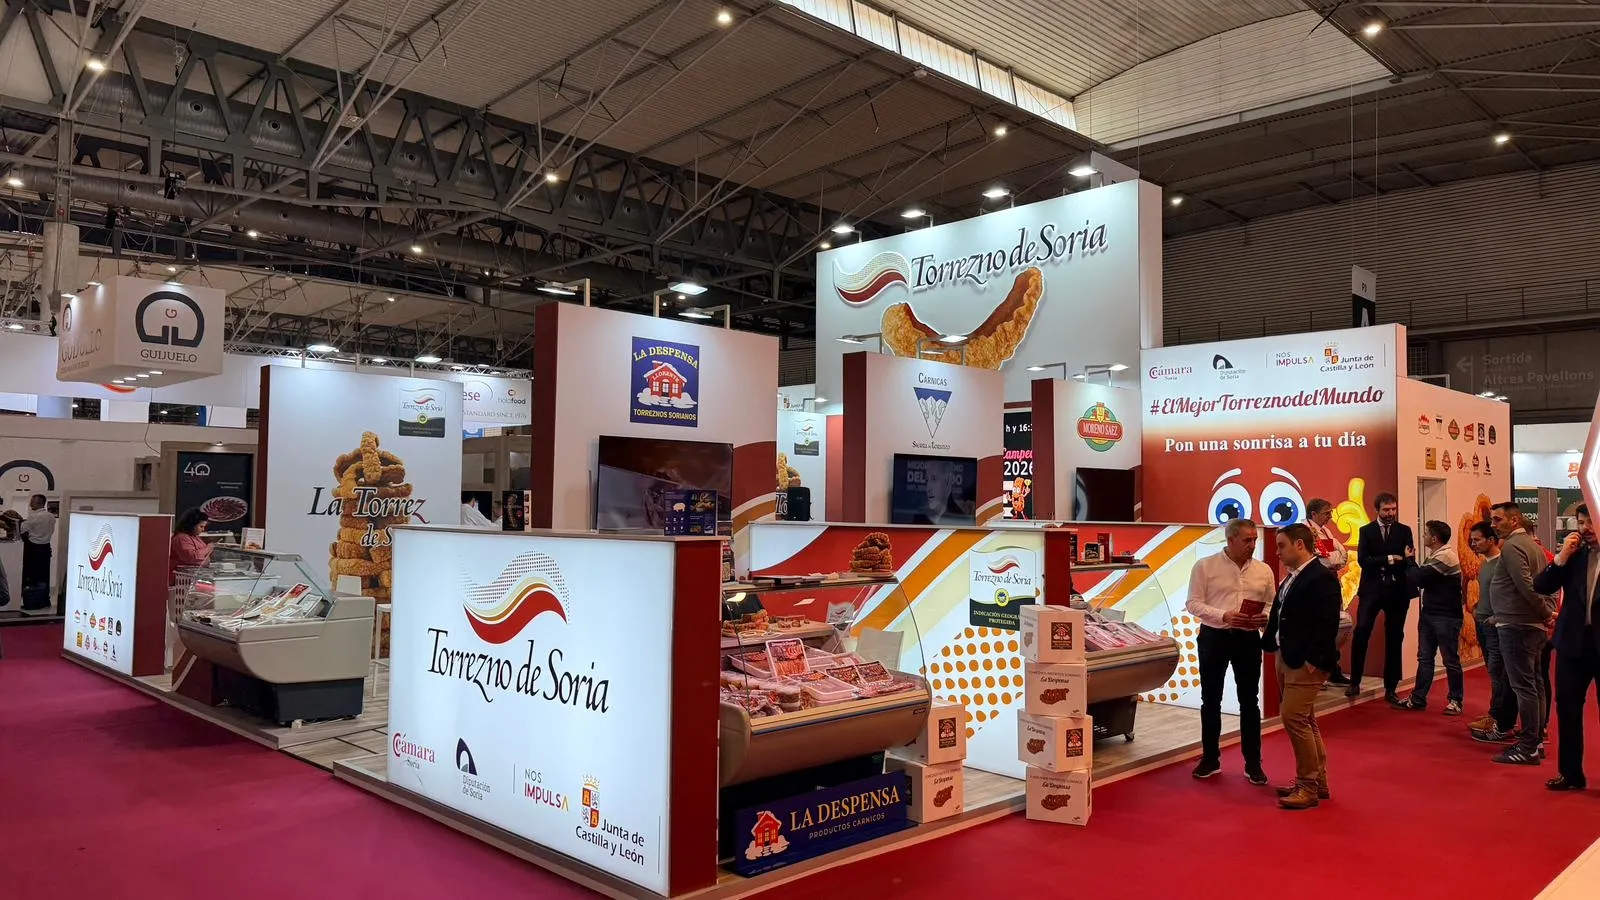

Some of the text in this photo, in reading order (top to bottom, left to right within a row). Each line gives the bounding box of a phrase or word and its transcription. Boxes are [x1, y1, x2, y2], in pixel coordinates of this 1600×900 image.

[911, 220, 1107, 288] Torrezno de Soria
[140, 348, 198, 363] GUIJUELO
[633, 346, 699, 369] LA DESPENSA
[1340, 356, 1362, 364] Junta
[1320, 365, 1347, 373] Castilla
[1354, 362, 1374, 370] León
[1483, 370, 1594, 385] Altres Pavellons
[1150, 385, 1385, 418] #ElMejorTorreznodelMundo
[633, 408, 697, 421] TORREZNOS SORIANOS
[1012, 425, 1017, 434] y
[1164, 431, 1367, 453] Pon una sonrisa a tu día
[307, 486, 431, 524] La Torrez
[360, 523, 380, 547] de
[77, 564, 100, 600] Torrezno
[106, 570, 123, 599] Soria
[973, 570, 1032, 586] Torrezno de Soria
[427, 627, 609, 714] Torrezno de Soria
[392, 732, 436, 764] Cámara
[462, 774, 491, 793] Diputación
[524, 768, 542, 784] NOS
[462, 786, 484, 801] de Soria
[789, 785, 901, 832] LA DESPENSA
[601, 818, 645, 847] Junta de
[808, 822, 851, 840] PRODUCTOS
[575, 825, 644, 866] Castilla y León
